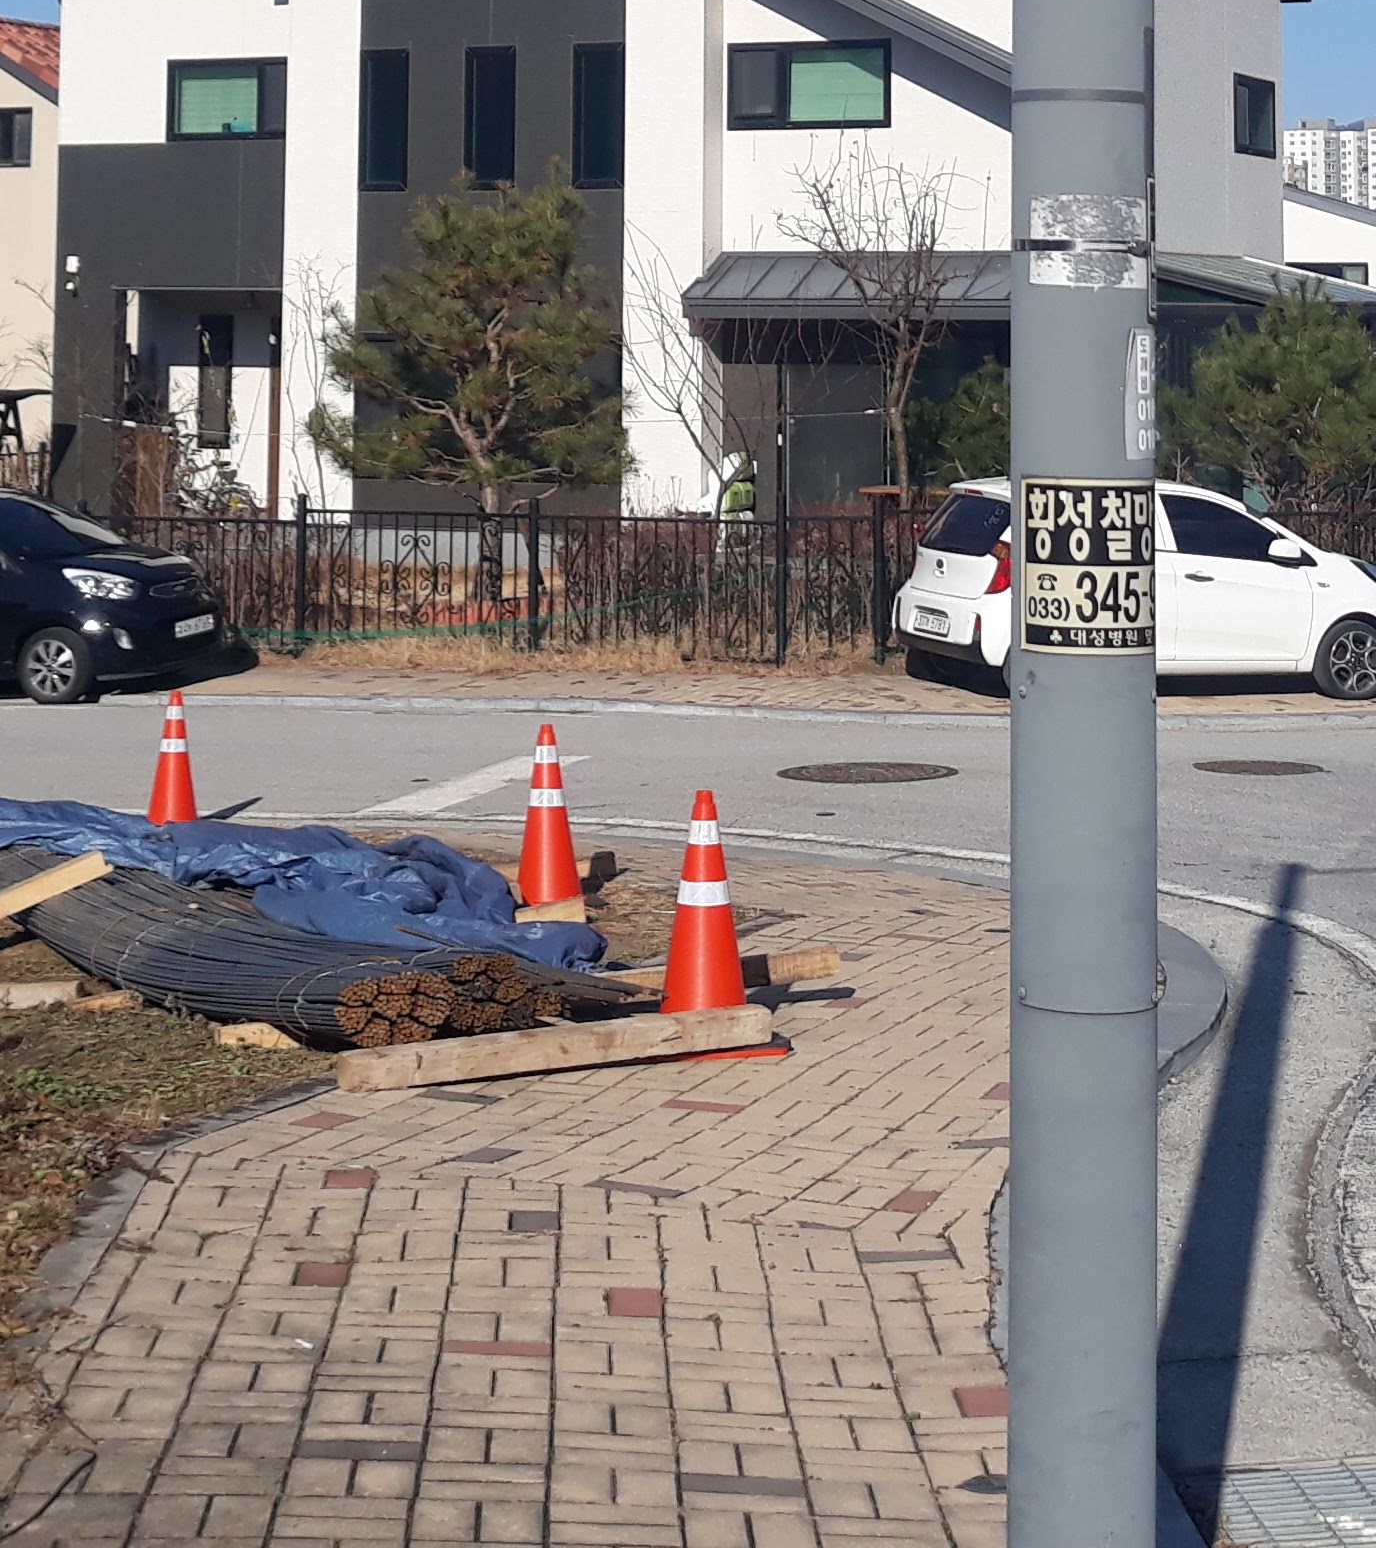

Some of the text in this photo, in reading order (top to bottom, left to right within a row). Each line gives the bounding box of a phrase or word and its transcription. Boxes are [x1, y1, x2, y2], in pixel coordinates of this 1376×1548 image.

[1027, 487, 1093, 562] 횡성
[1028, 596, 1071, 622] 033)
[1070, 629, 1138, 646] 대성병원
